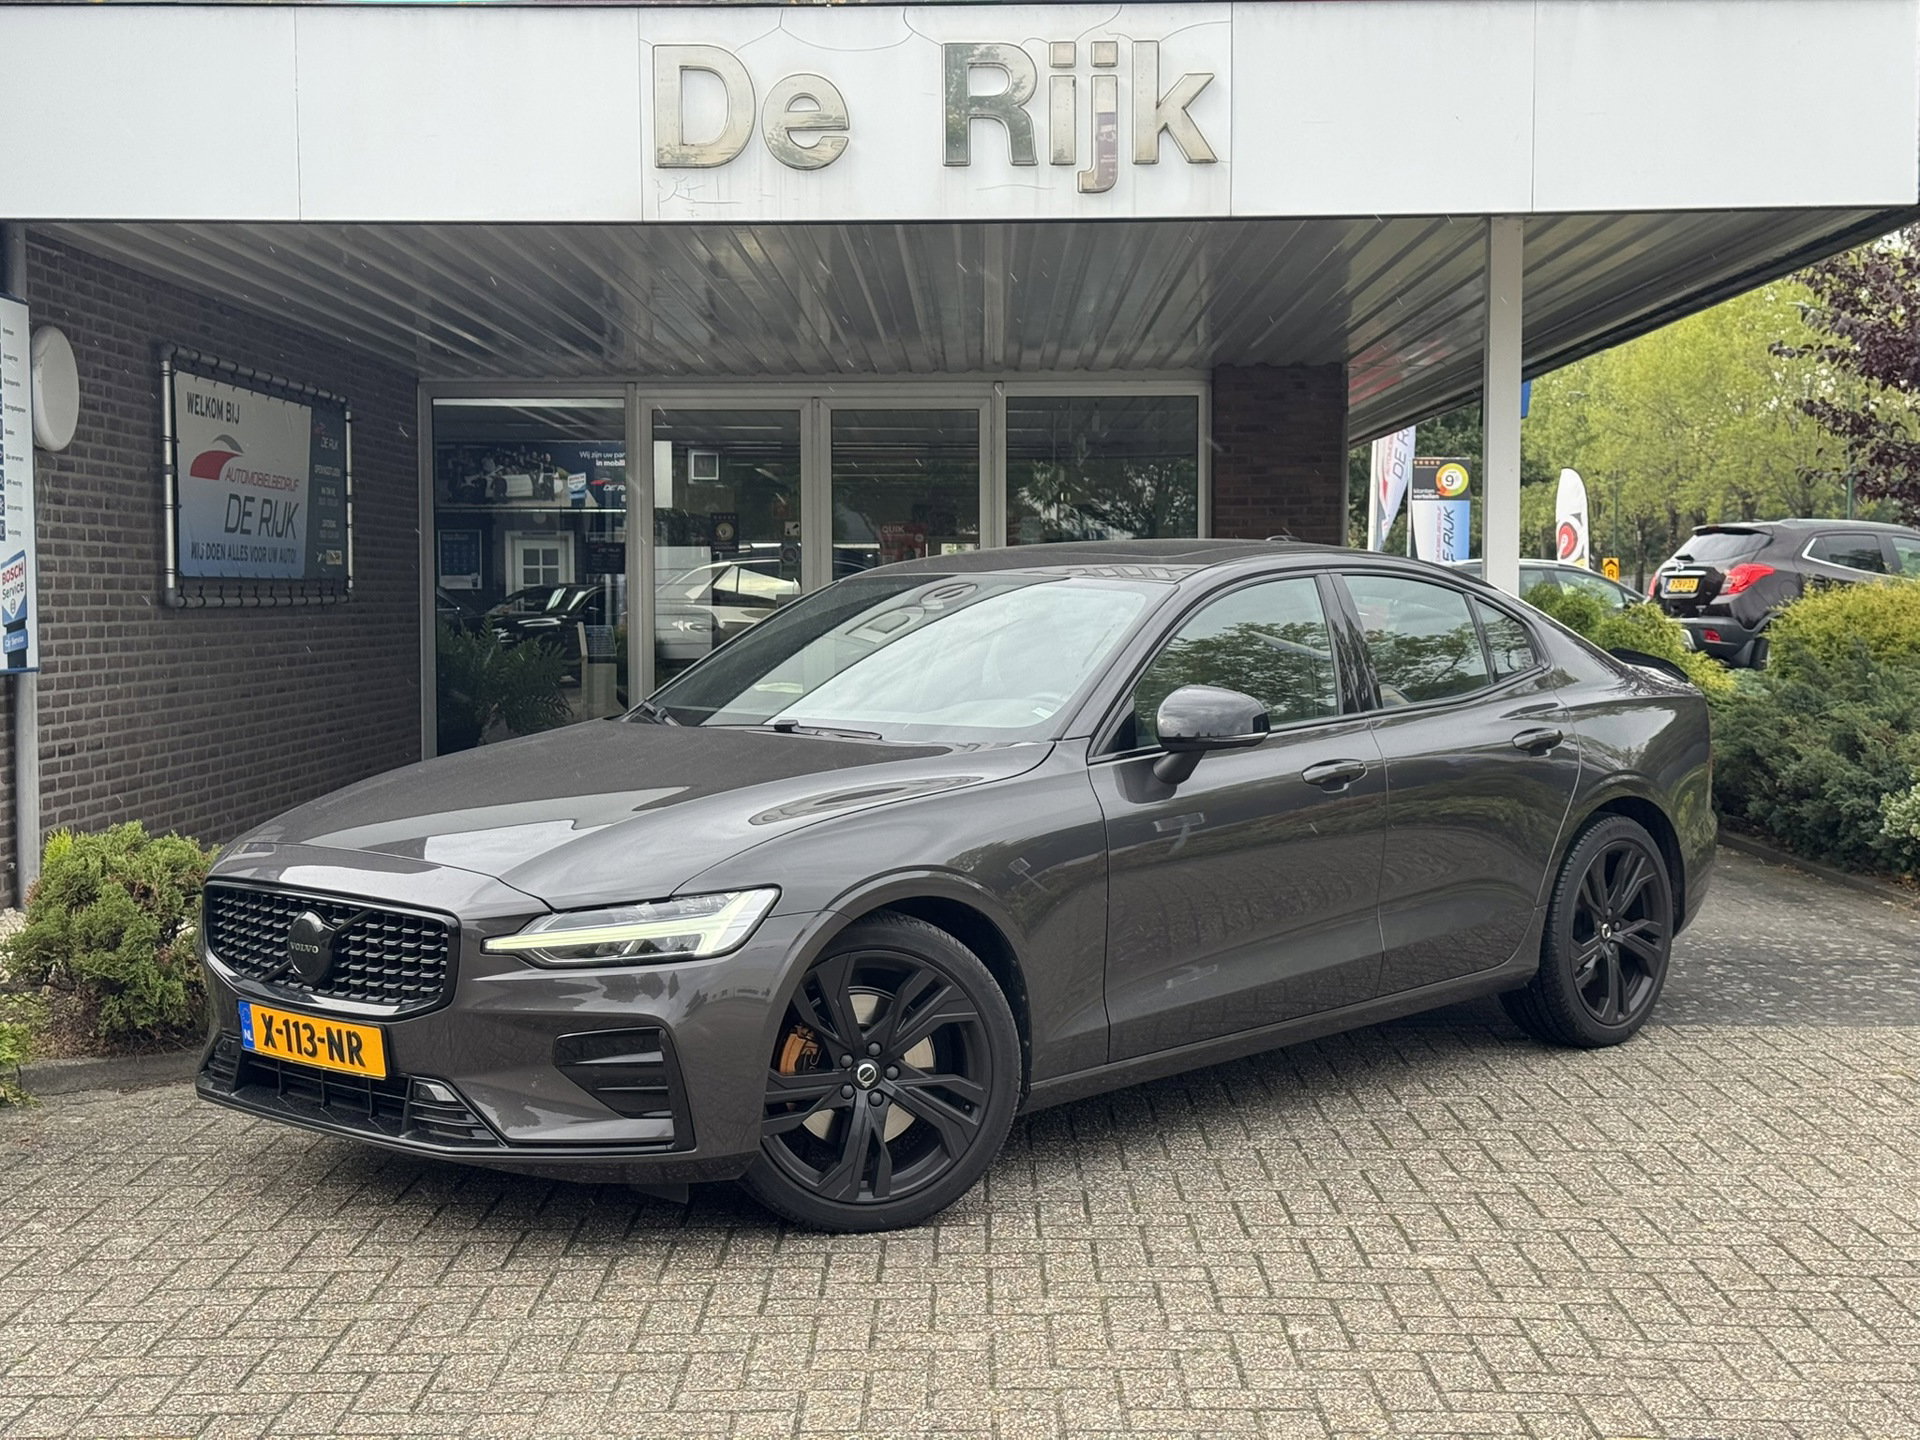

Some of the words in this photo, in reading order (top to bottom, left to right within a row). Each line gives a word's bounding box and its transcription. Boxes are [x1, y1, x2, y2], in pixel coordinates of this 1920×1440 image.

[652, 43, 850, 171] De
[940, 40, 1219, 194] Rijk
[187, 391, 224, 421] WELKOM
[226, 403, 240, 425] BIJ
[579, 450, 590, 460] Wij
[591, 450, 602, 460] zijn
[1393, 448, 1407, 480] DE
[226, 467, 299, 492] AUTOMOBIELBEDRIJF
[224, 493, 255, 536] DE
[258, 498, 299, 540] RIJK
[1442, 506, 1455, 548] RIJK
[206, 542, 226, 560] DOEN
[228, 544, 248, 562] ALLES
[250, 546, 266, 562] VOOR
[2, 561, 24, 586] BOSCH
[2, 581, 24, 600] Service
[290, 942, 319, 954] VOLVO
[244, 1029, 254, 1042] NL
[260, 1012, 366, 1068] X-113-NR
